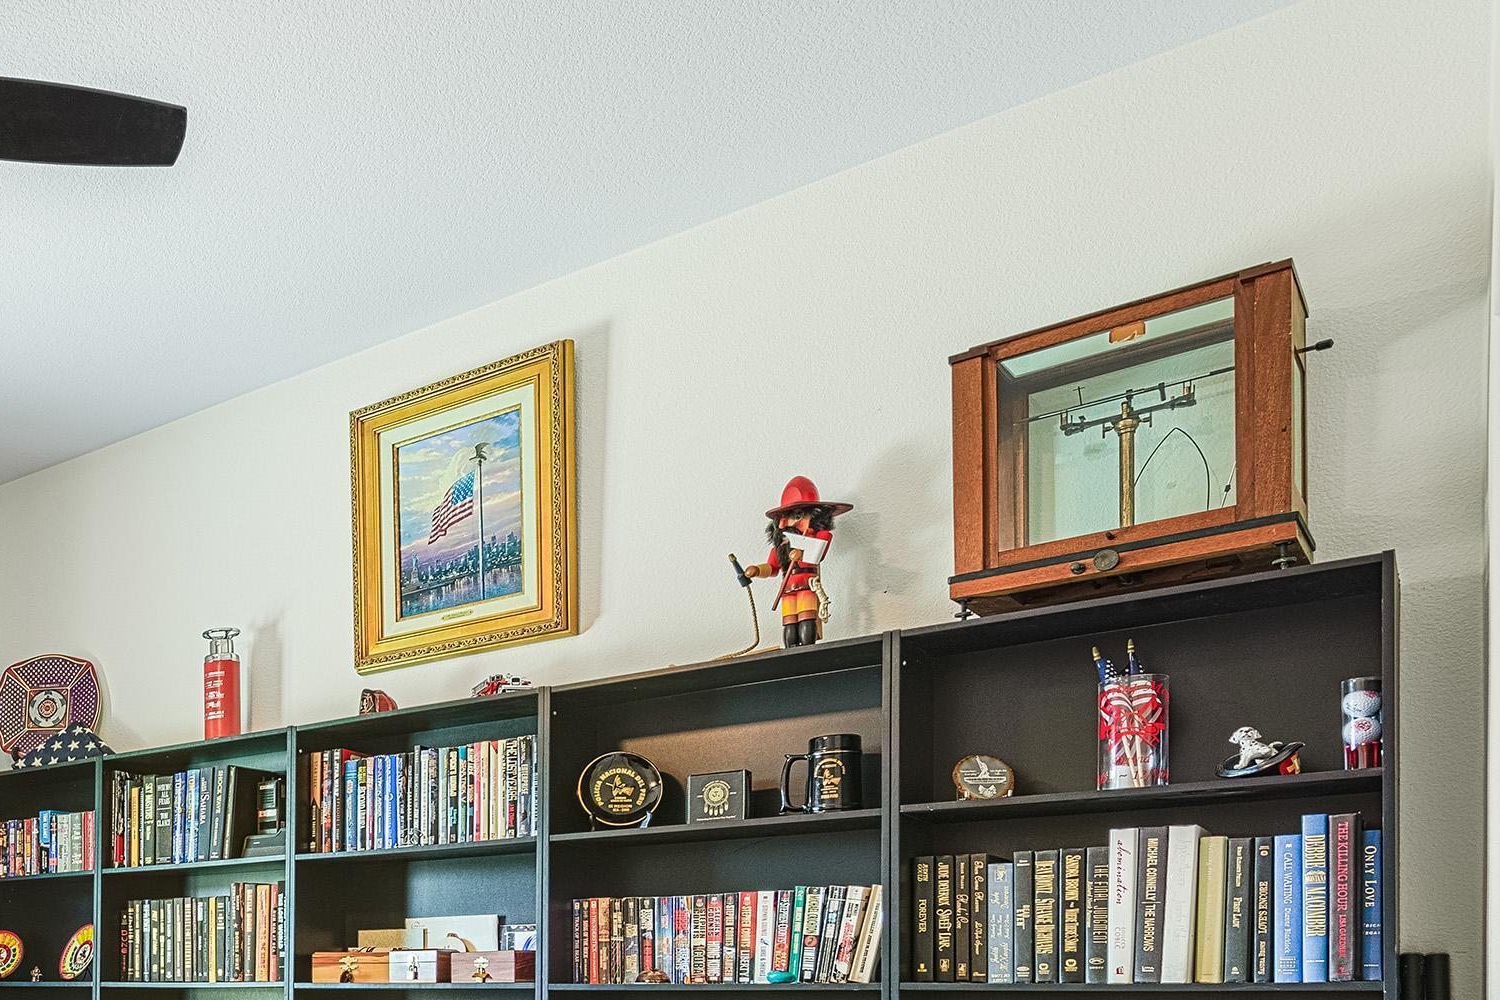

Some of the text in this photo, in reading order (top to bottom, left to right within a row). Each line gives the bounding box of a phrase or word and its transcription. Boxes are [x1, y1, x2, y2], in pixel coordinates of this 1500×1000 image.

[520, 764, 528, 795] ENTERPRISE
[599, 767, 636, 782] NACIONAL
[634, 775, 646, 788] DEL
[145, 782, 153, 820] SKY MASTERS
[594, 780, 604, 807] POLICIA
[636, 788, 647, 807] PERU
[200, 794, 210, 824] SAHARA
[1338, 822, 1348, 840] THE
[1115, 839, 1132, 904] abomination
[1336, 842, 1348, 882] KILLING
[1364, 845, 1378, 875] ONLY
[936, 862, 951, 952] JUDE DEVERAUX SWEET LIAR
[1092, 864, 1108, 944] THE FINAL JUDGMENT
[1143, 838, 1158, 952] MICHAEL CONNELLY THE NARROWS
[1258, 880, 1269, 910] ENCORE
[1336, 882, 1348, 912] HOUR
[1364, 880, 1378, 908] LOVE
[918, 898, 927, 933] FOREVER
[1258, 910, 1268, 934] LOVE'S
[1338, 914, 1347, 928] LISA
